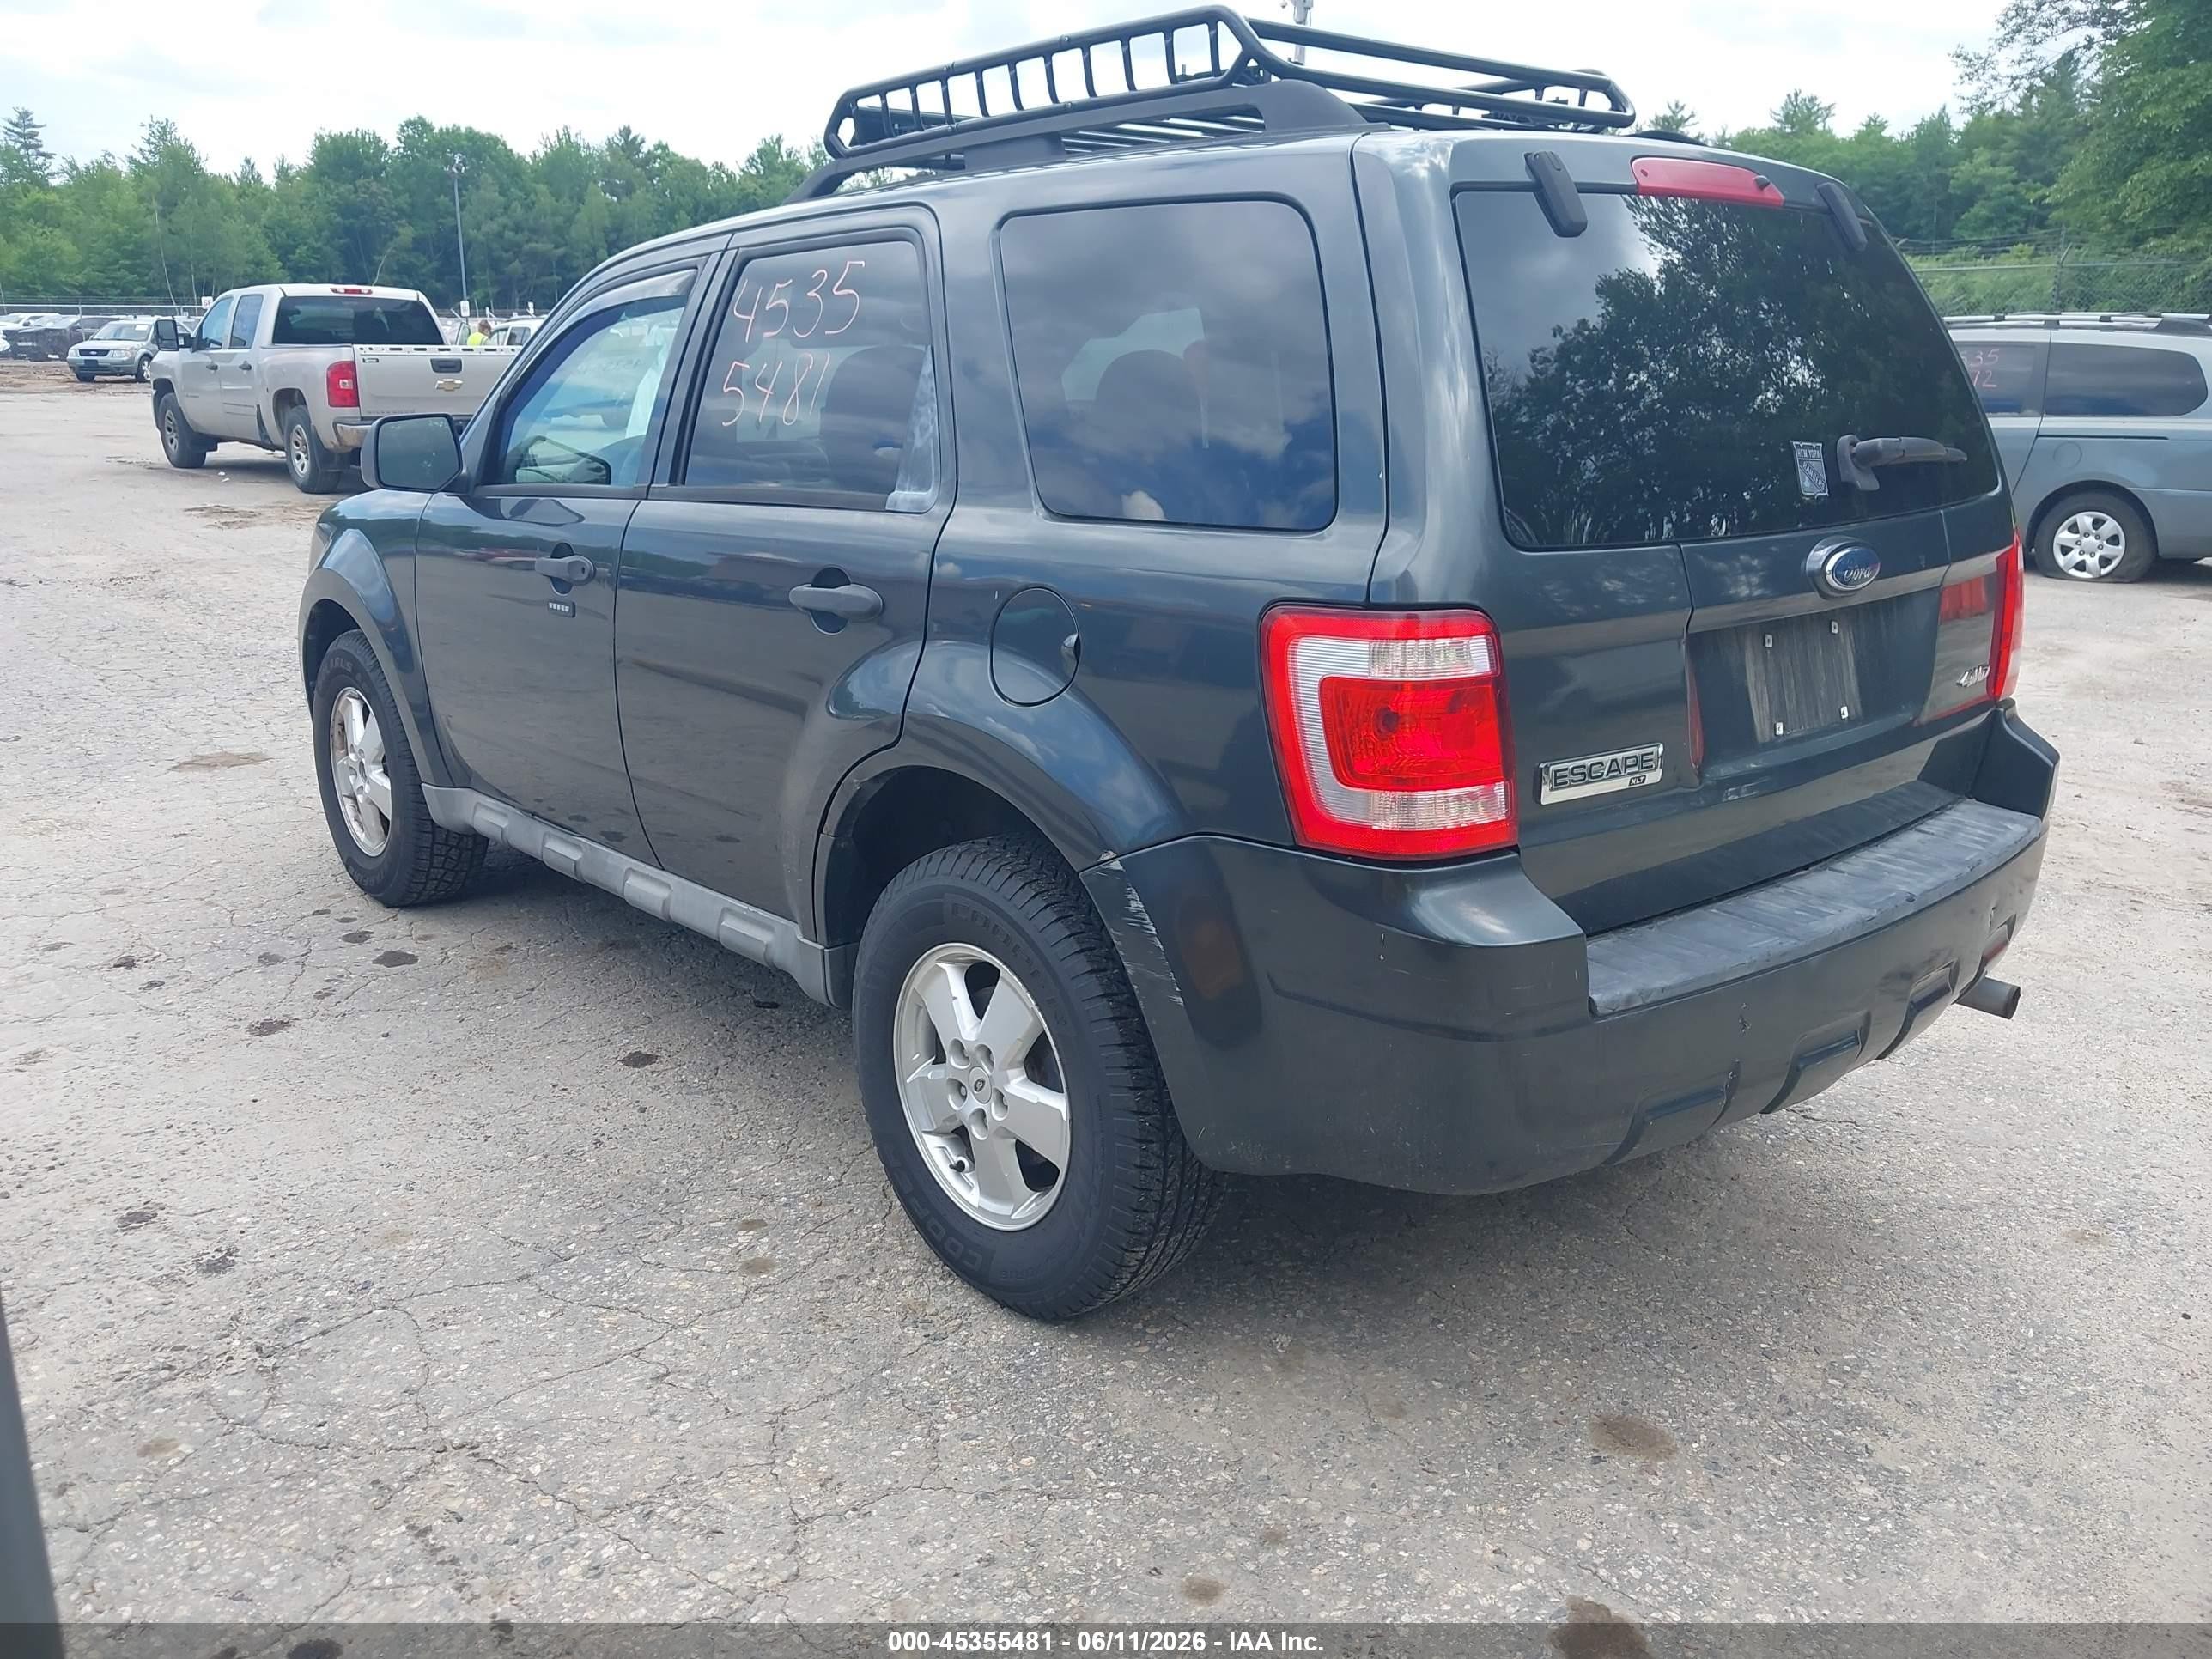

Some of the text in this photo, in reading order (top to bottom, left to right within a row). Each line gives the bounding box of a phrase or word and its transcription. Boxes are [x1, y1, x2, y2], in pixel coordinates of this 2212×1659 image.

[732, 260, 866, 343] 4535
[721, 352, 830, 426] 5481
[1552, 751, 1655, 787] ESCAPE
[1629, 775, 1646, 787] XLT
